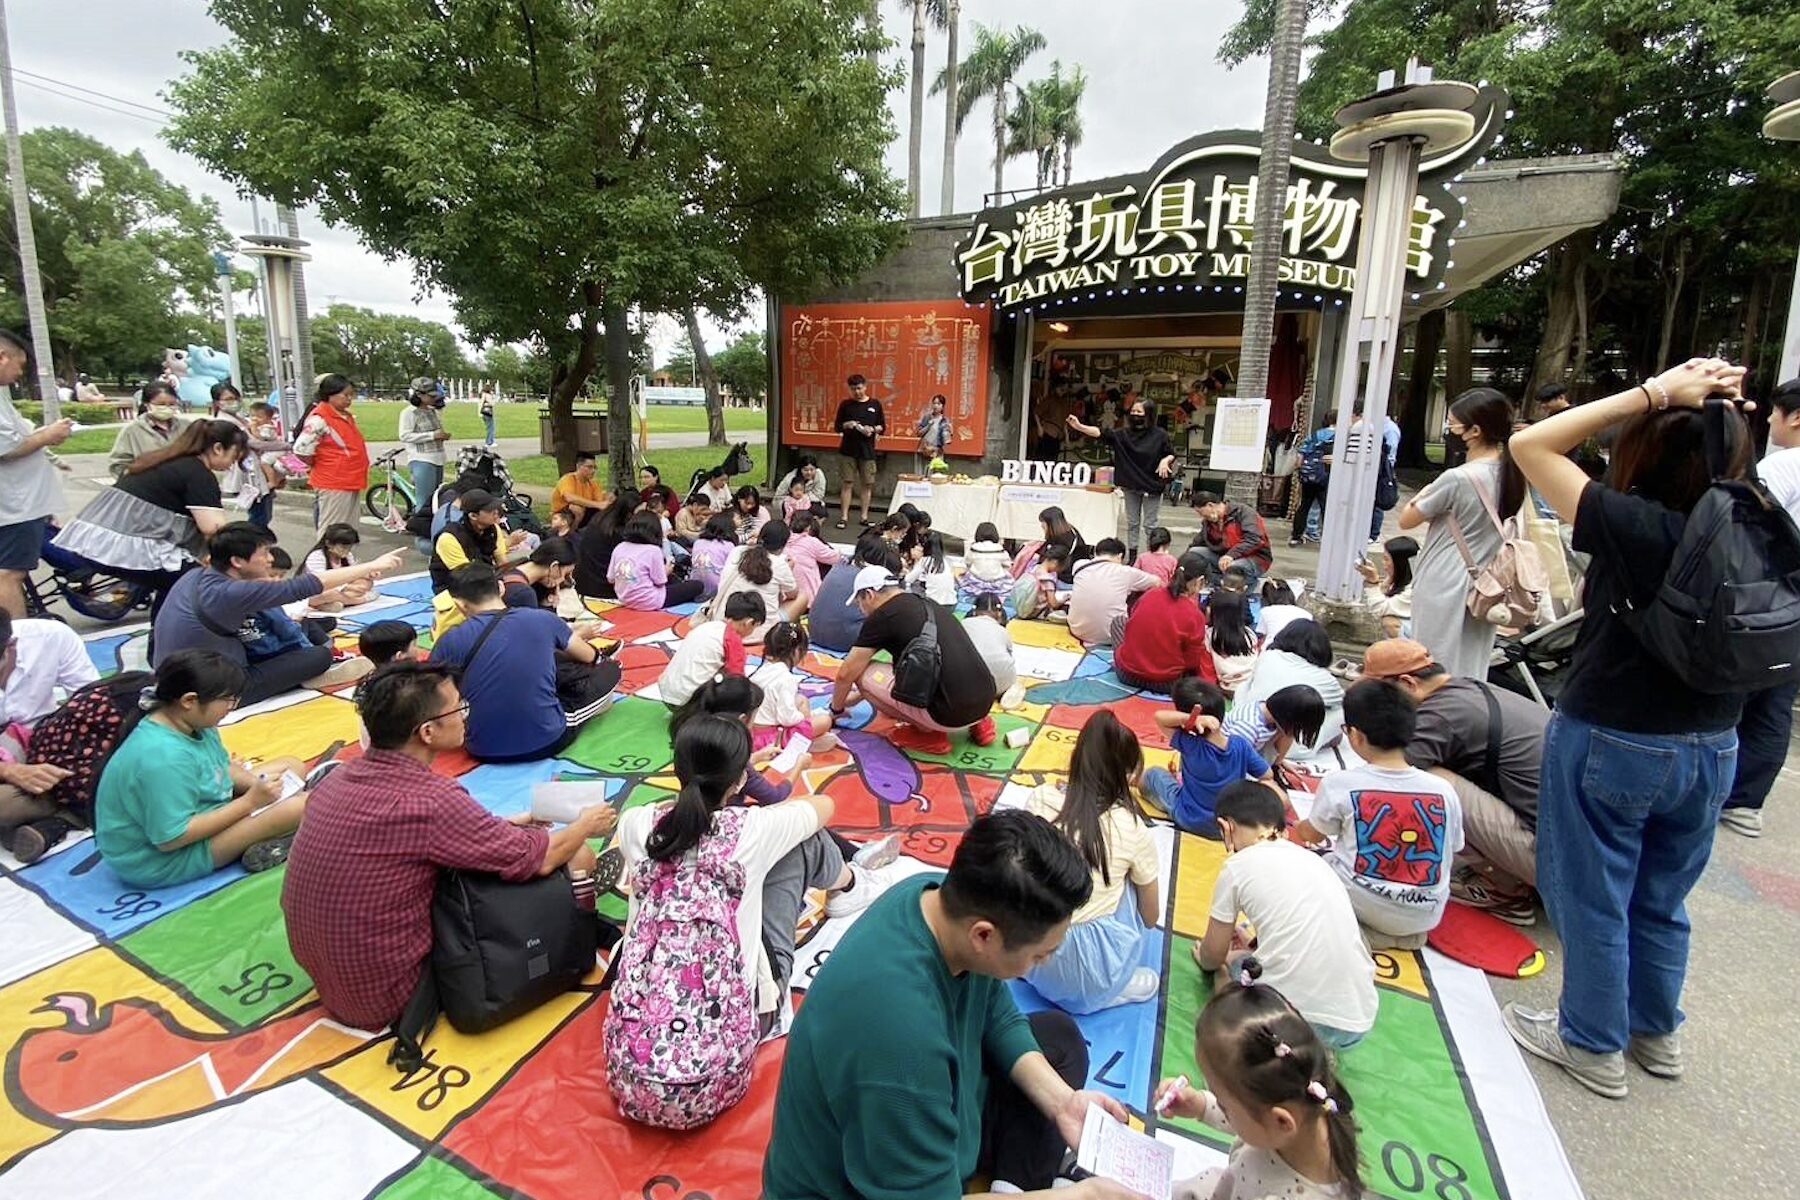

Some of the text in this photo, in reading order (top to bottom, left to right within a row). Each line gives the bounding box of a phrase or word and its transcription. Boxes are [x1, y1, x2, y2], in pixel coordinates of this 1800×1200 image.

[1000, 251, 1357, 306] TAIWAN TOY MSEU
[1001, 459, 1091, 485] BINGO
